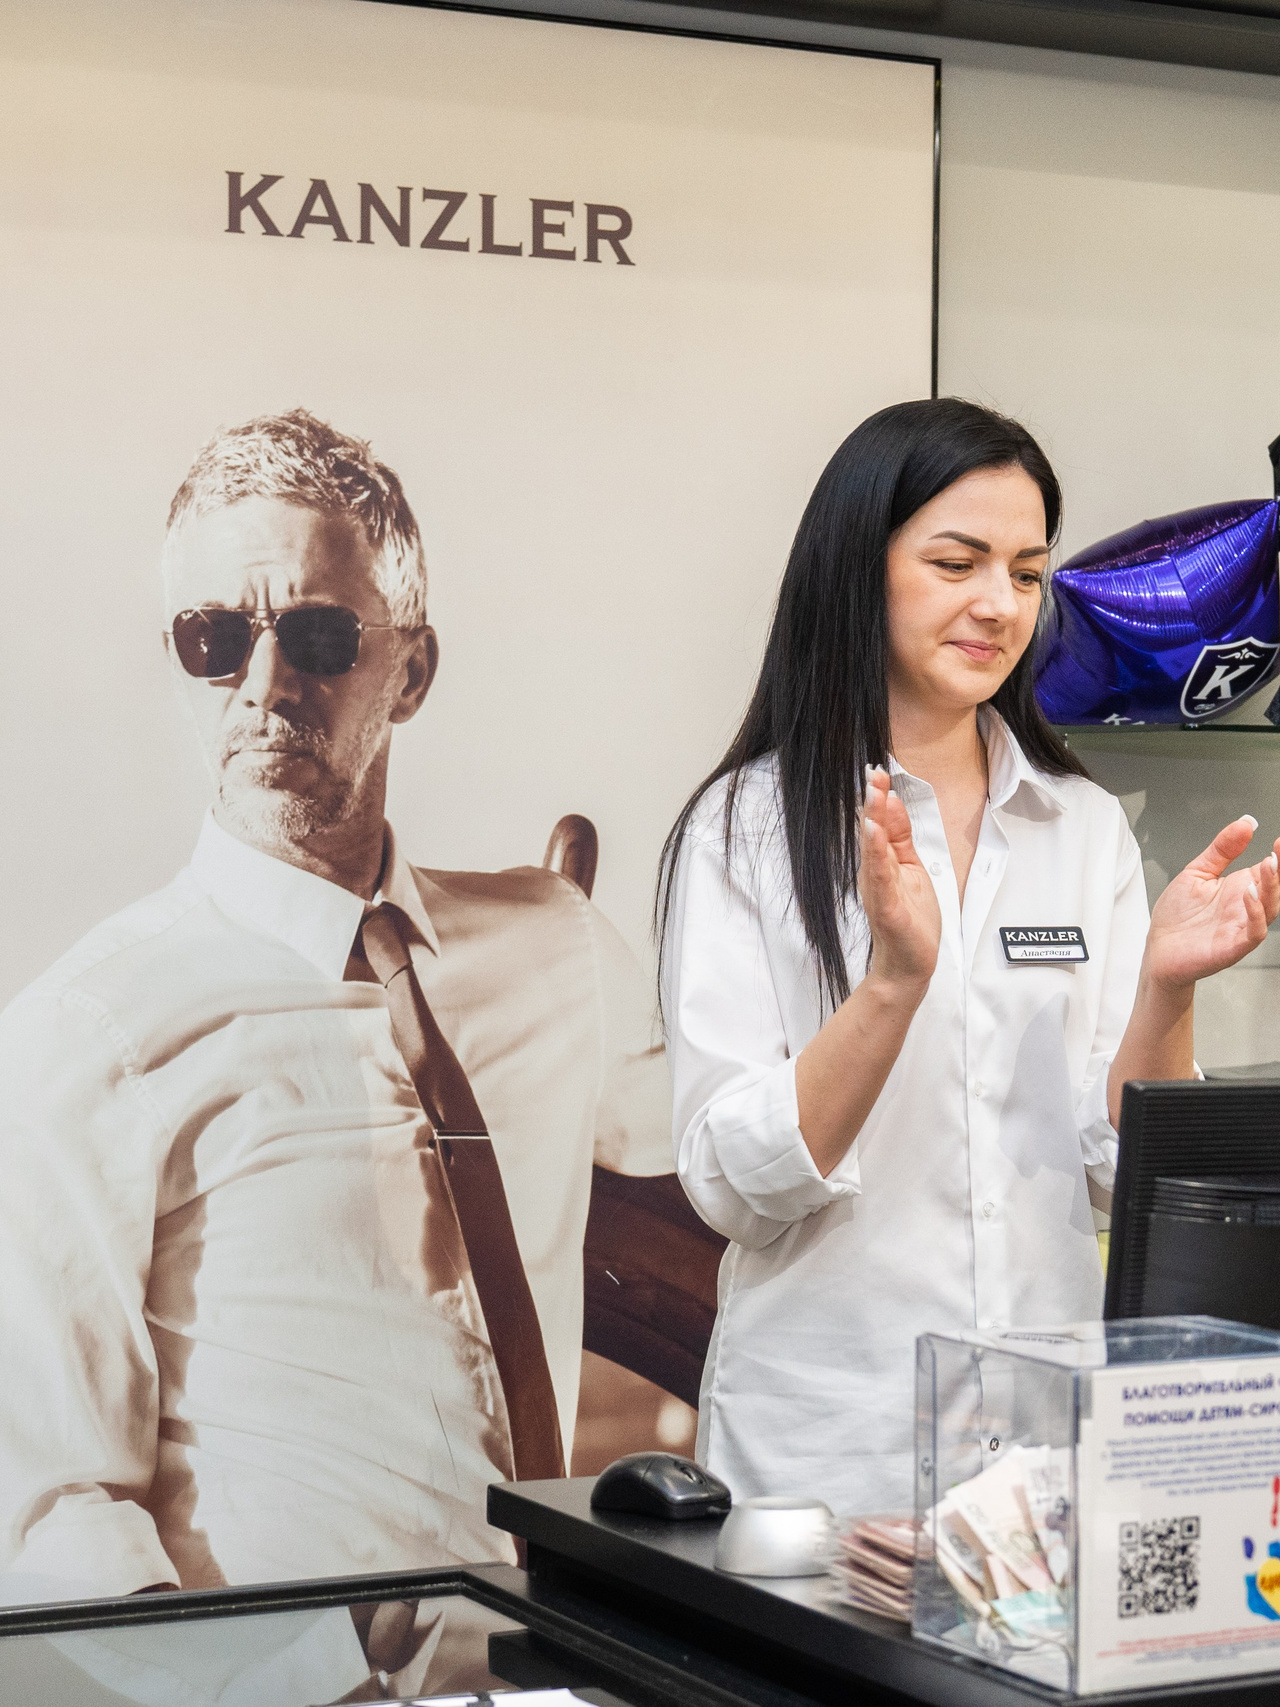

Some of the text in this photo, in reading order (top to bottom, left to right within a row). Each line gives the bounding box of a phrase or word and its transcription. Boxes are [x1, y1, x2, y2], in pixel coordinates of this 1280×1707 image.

[224, 170, 637, 267] KANZLER
[1192, 664, 1255, 700] K
[1004, 931, 1080, 942] KANZLER
[1020, 949, 1071, 958] Анастасия
[1122, 1373, 1275, 1401] БЛАГОТВОРИТЕЛЬНЫЙ
[1123, 1409, 1195, 1427] ПОМОЩИ
